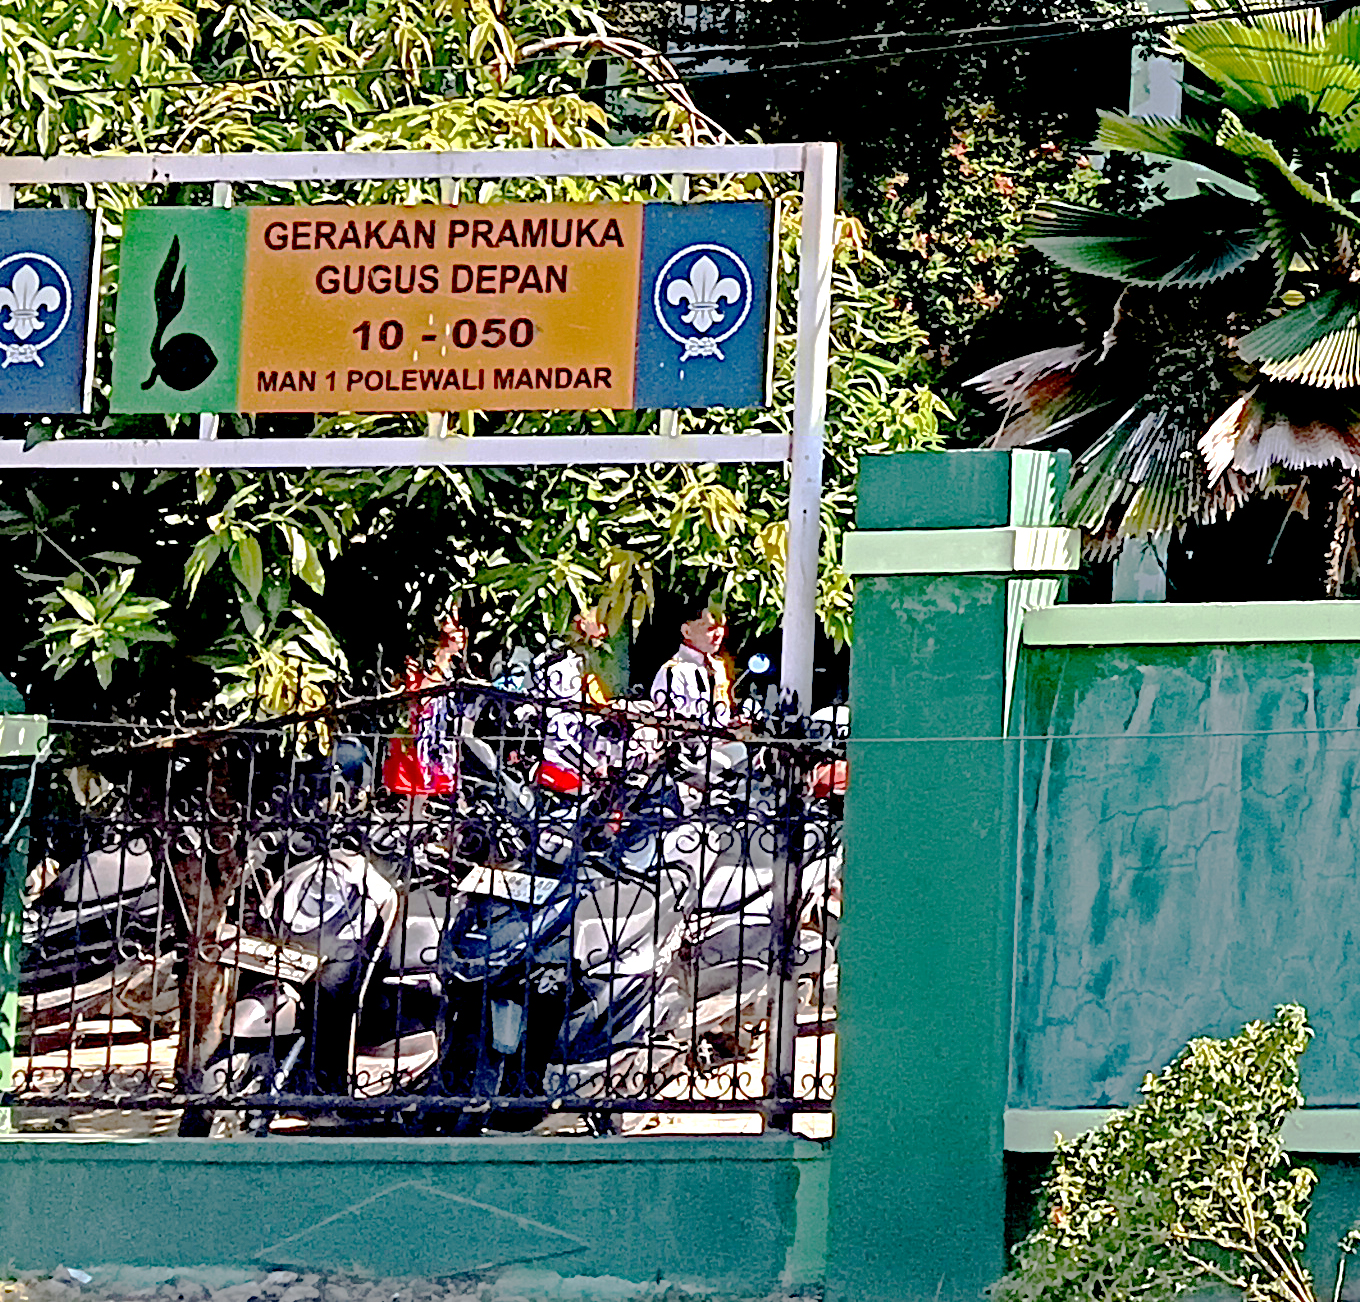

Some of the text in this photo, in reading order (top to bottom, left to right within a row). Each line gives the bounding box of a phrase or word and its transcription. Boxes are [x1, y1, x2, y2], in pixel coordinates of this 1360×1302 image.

[264, 217, 625, 251] GERAKAN PRAMUKA
[315, 263, 568, 295] GUGUS DEPAN
[352, 319, 404, 351] 10
[451, 317, 534, 349] 050
[257, 367, 612, 393] MAN 1 POLEWALI MANDAR
